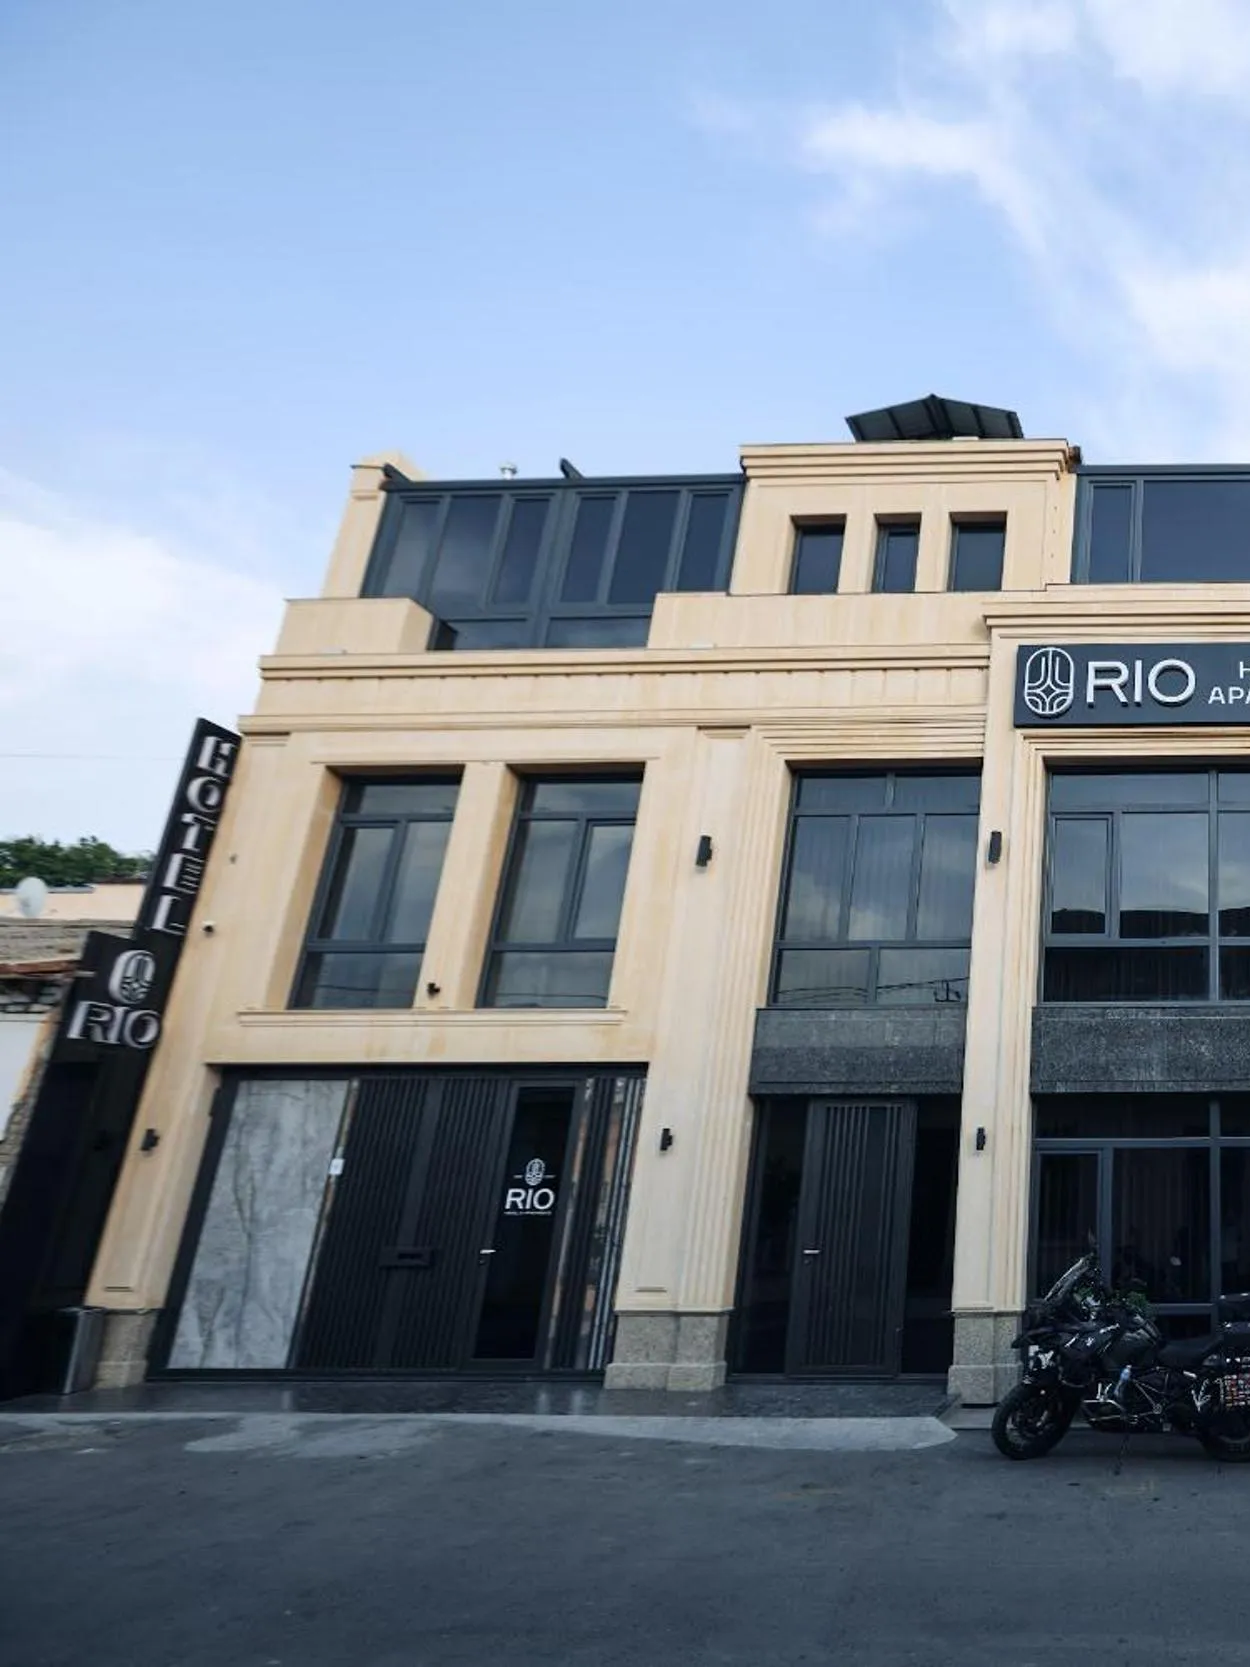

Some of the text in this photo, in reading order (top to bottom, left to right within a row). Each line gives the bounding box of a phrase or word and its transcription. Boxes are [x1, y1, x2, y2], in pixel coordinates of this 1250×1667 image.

[1086, 659, 1196, 704] RIO
[150, 735, 236, 936] HOTEL
[67, 1001, 161, 1049] RIO
[505, 1188, 555, 1210] RIO
